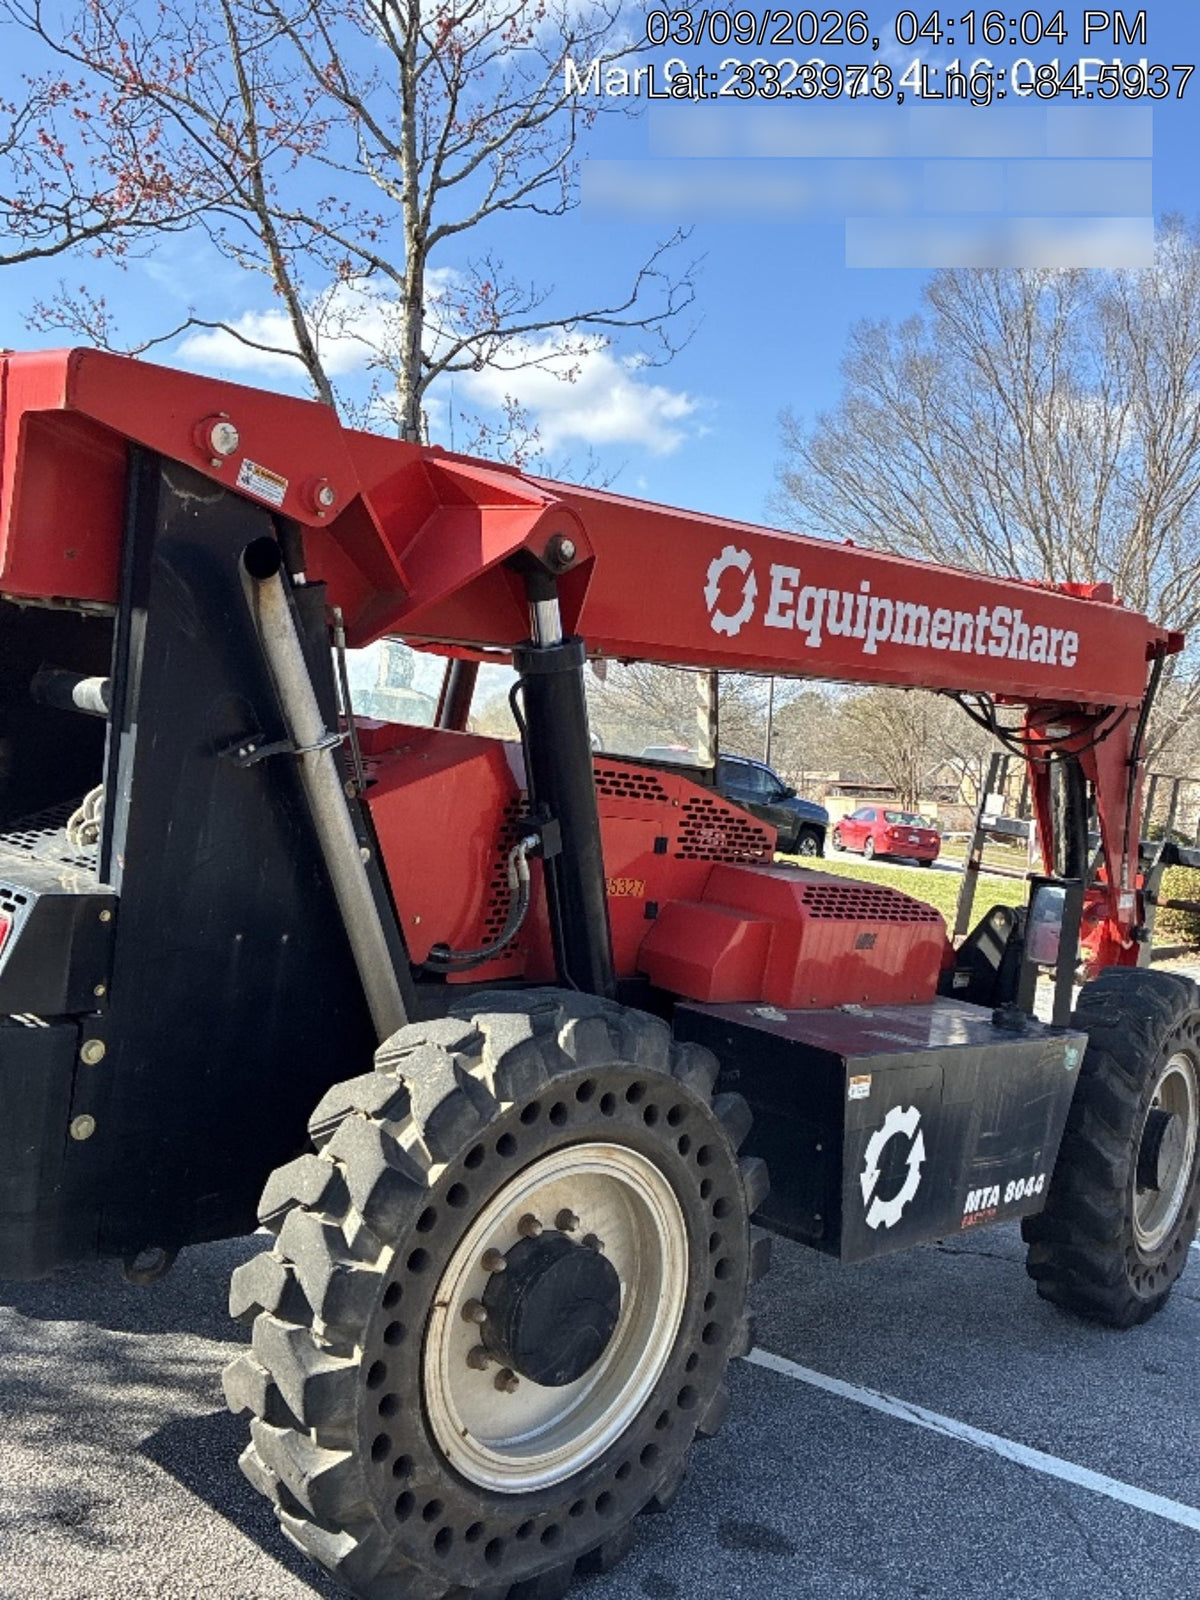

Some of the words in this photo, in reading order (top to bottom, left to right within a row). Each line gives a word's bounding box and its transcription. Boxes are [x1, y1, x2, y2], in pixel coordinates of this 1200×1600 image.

[763, 563, 1079, 668] EquipmentShare
[963, 1185, 1001, 1214] MTA
[1004, 1173, 1046, 1203] 8044
